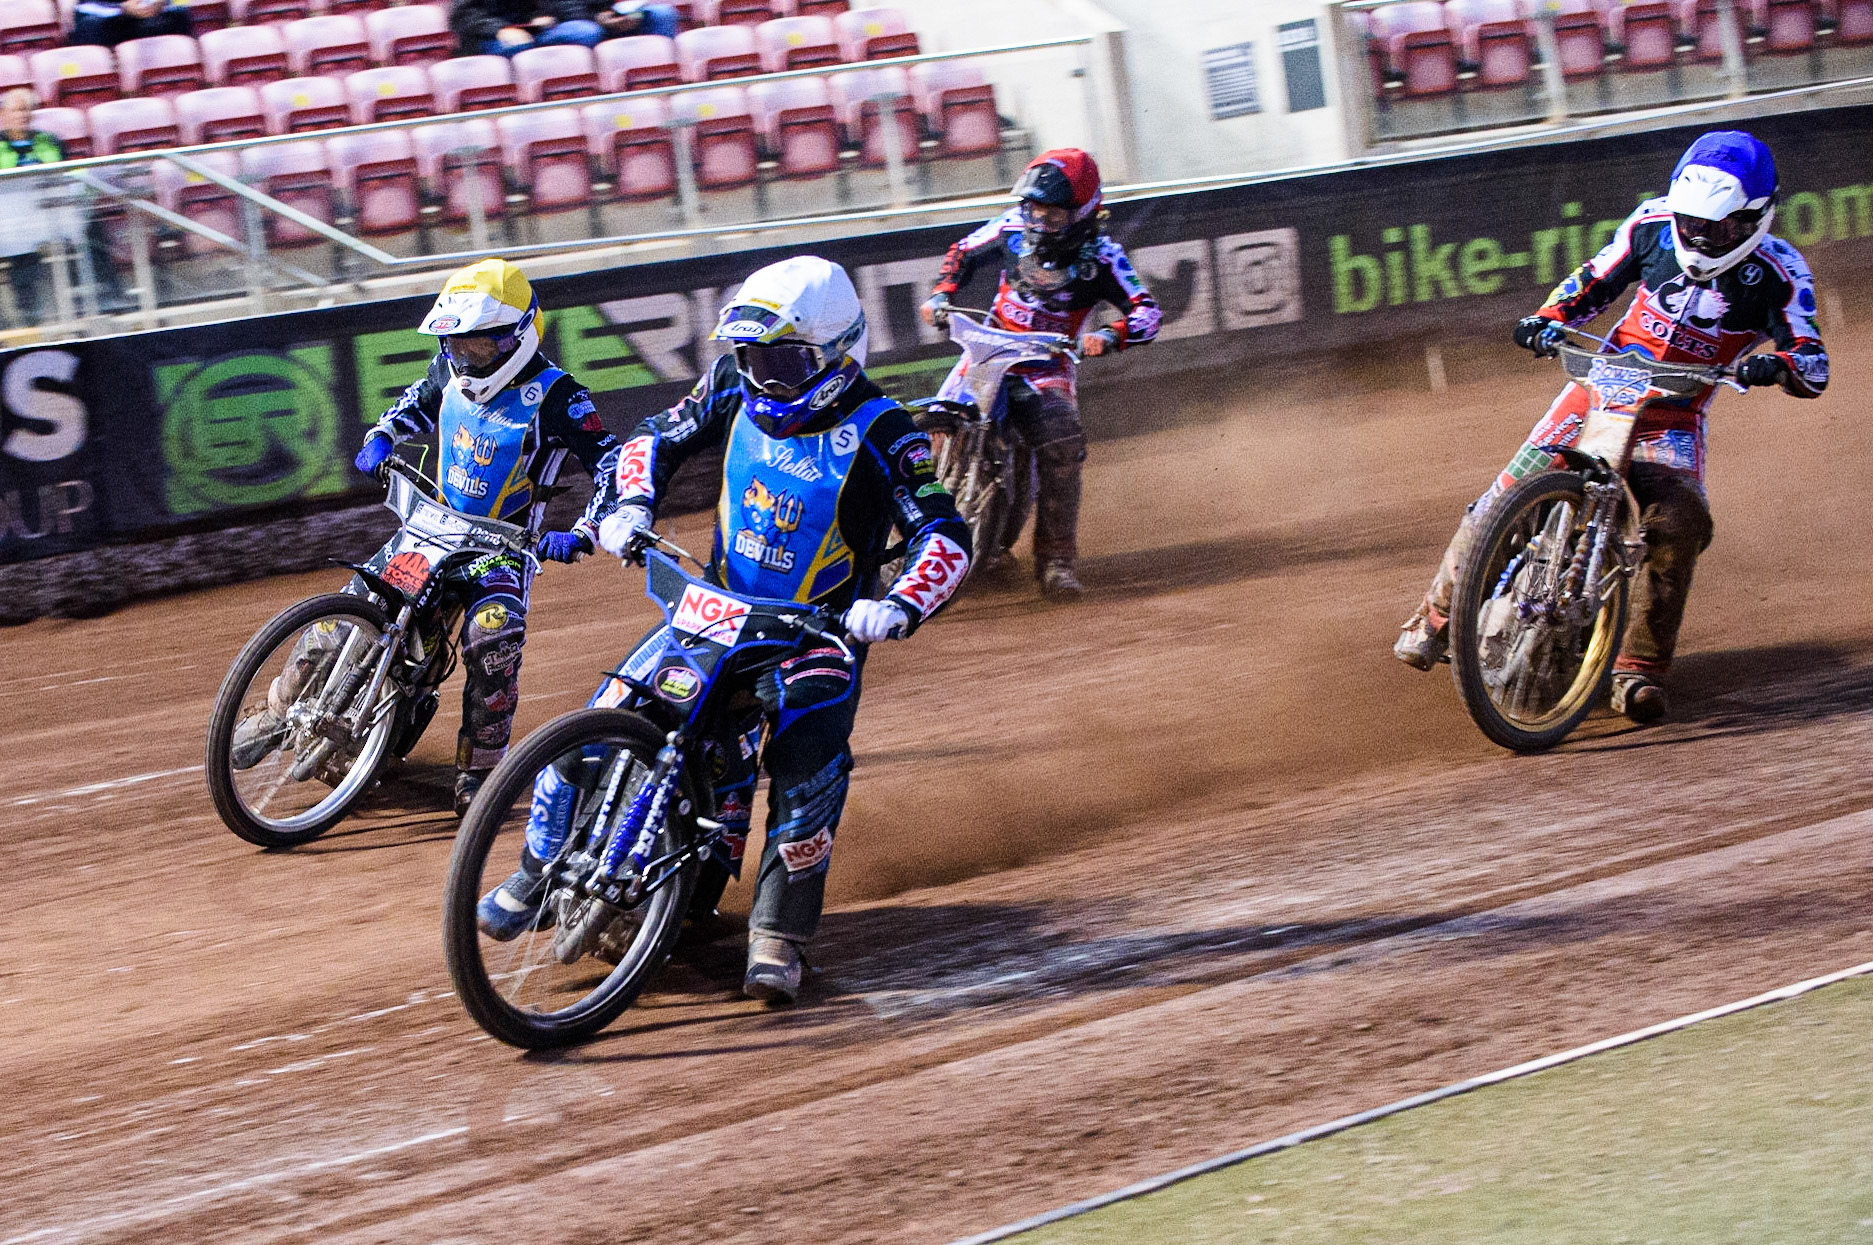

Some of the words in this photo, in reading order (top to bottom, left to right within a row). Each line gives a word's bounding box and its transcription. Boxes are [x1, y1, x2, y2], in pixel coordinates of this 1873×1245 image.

[1641, 310, 1718, 359] COLTS
[524, 386, 539, 401] 6
[840, 431, 855, 450] 5
[447, 468, 489, 497] DEVILS
[621, 439, 651, 494] NGK
[766, 444, 824, 483] Stellar
[734, 533, 796, 572] DEVILS
[898, 539, 965, 607] NGK
[676, 617, 702, 633] SPARK
[680, 590, 746, 632] NGK
[785, 831, 827, 862] NGK
